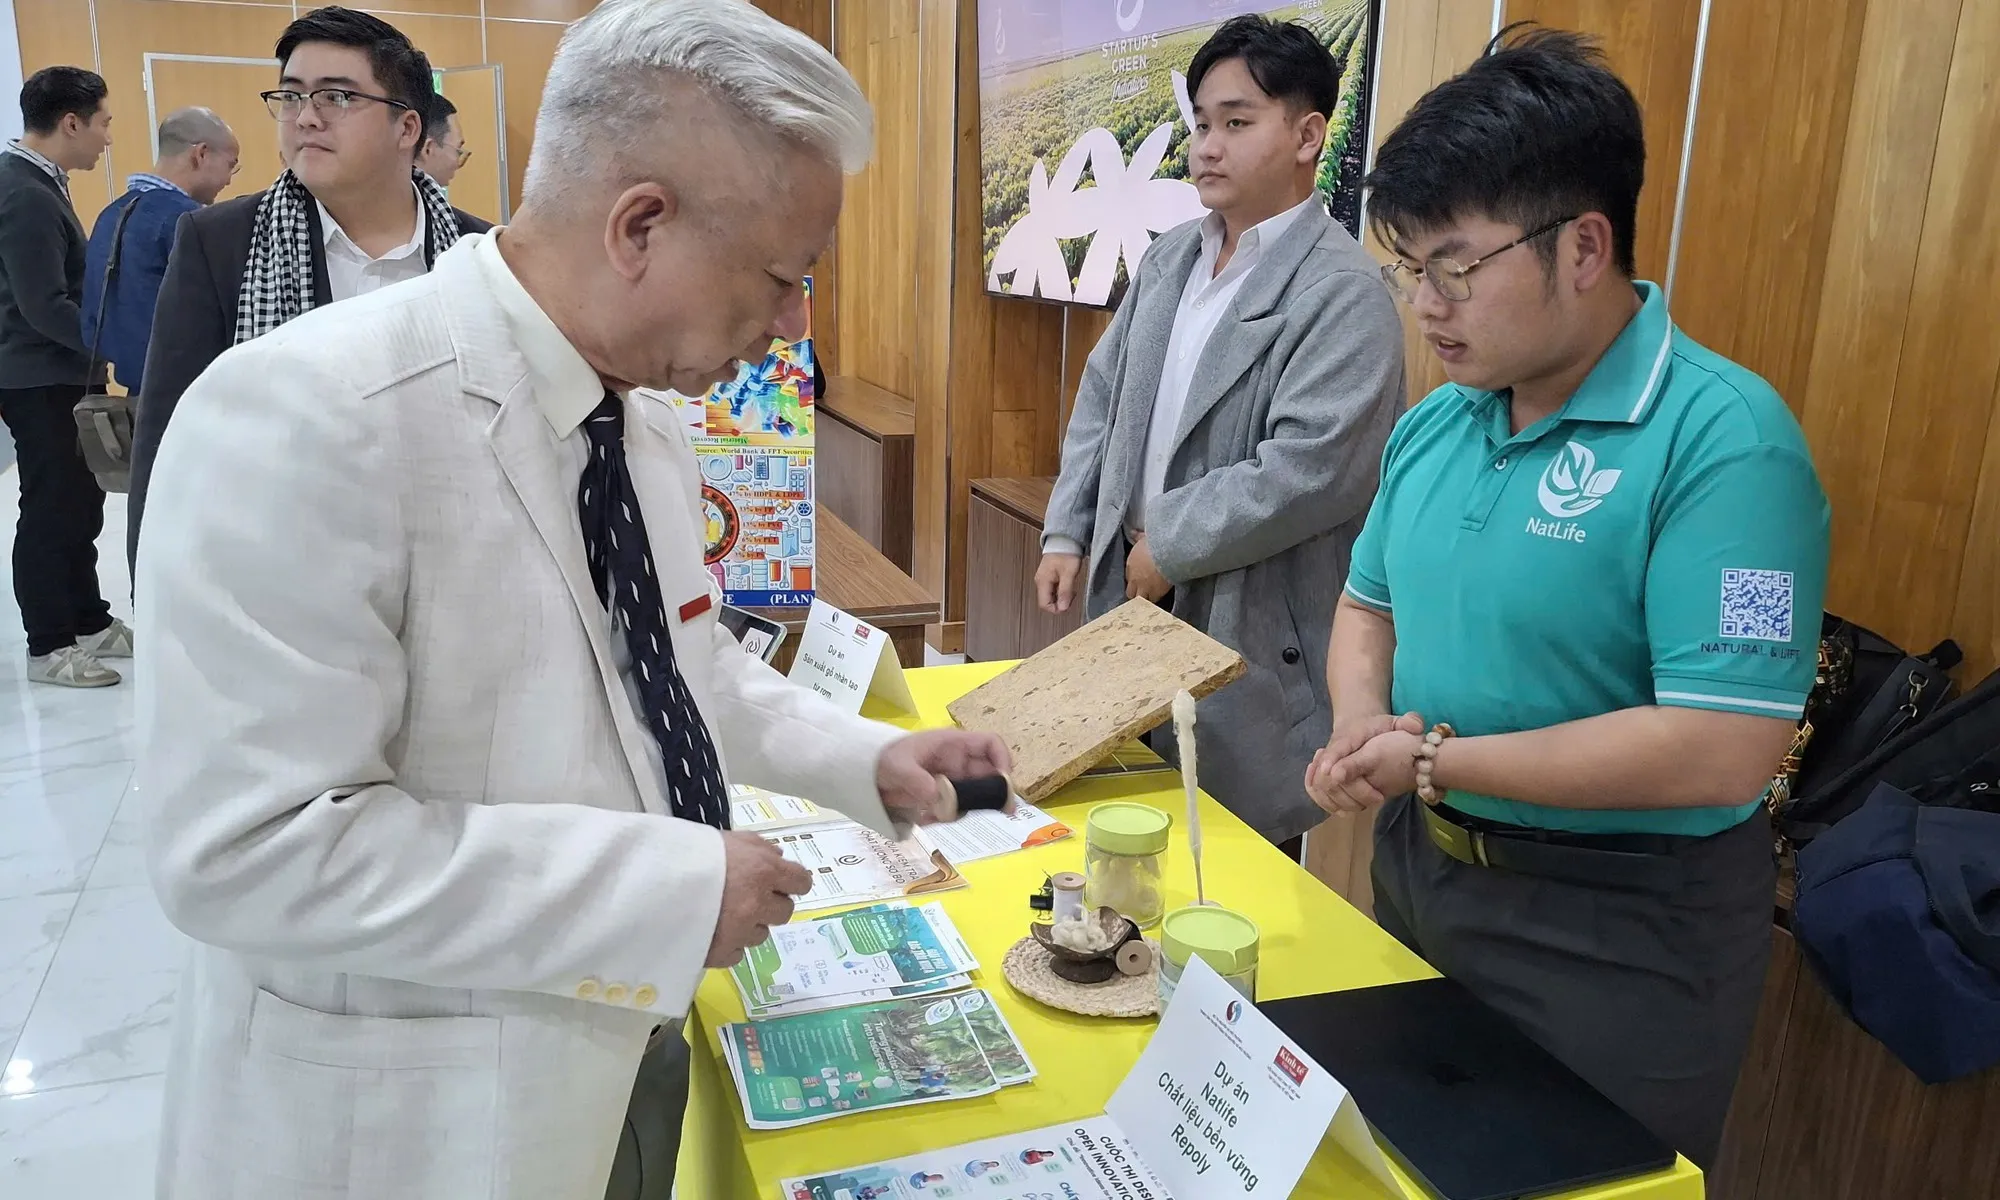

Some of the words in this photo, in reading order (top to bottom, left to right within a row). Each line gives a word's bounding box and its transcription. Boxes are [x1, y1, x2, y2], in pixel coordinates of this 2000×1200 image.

[1102, 32, 1158, 58] STARTUP'S
[1111, 54, 1147, 75] GREEN
[1525, 516, 1587, 543] NatLife
[769, 593, 814, 606] (PLAN)
[1700, 642, 1767, 656] NATURAL
[1770, 646, 1777, 658] &
[1279, 1048, 1298, 1070] Kinh
[1213, 1060, 1234, 1089] Dự
[1233, 1081, 1251, 1105] án
[1200, 1081, 1238, 1129] Natlife
[1074, 1128, 1098, 1151] OPEN
[1158, 1071, 1185, 1107] Chất
[1181, 1097, 1205, 1129] liệu
[1202, 1120, 1227, 1154] bền
[1226, 1148, 1259, 1192] vững
[1100, 1136, 1126, 1164] CUỘC
[1121, 1164, 1139, 1180] THI
[1170, 1123, 1212, 1176] Repoly
